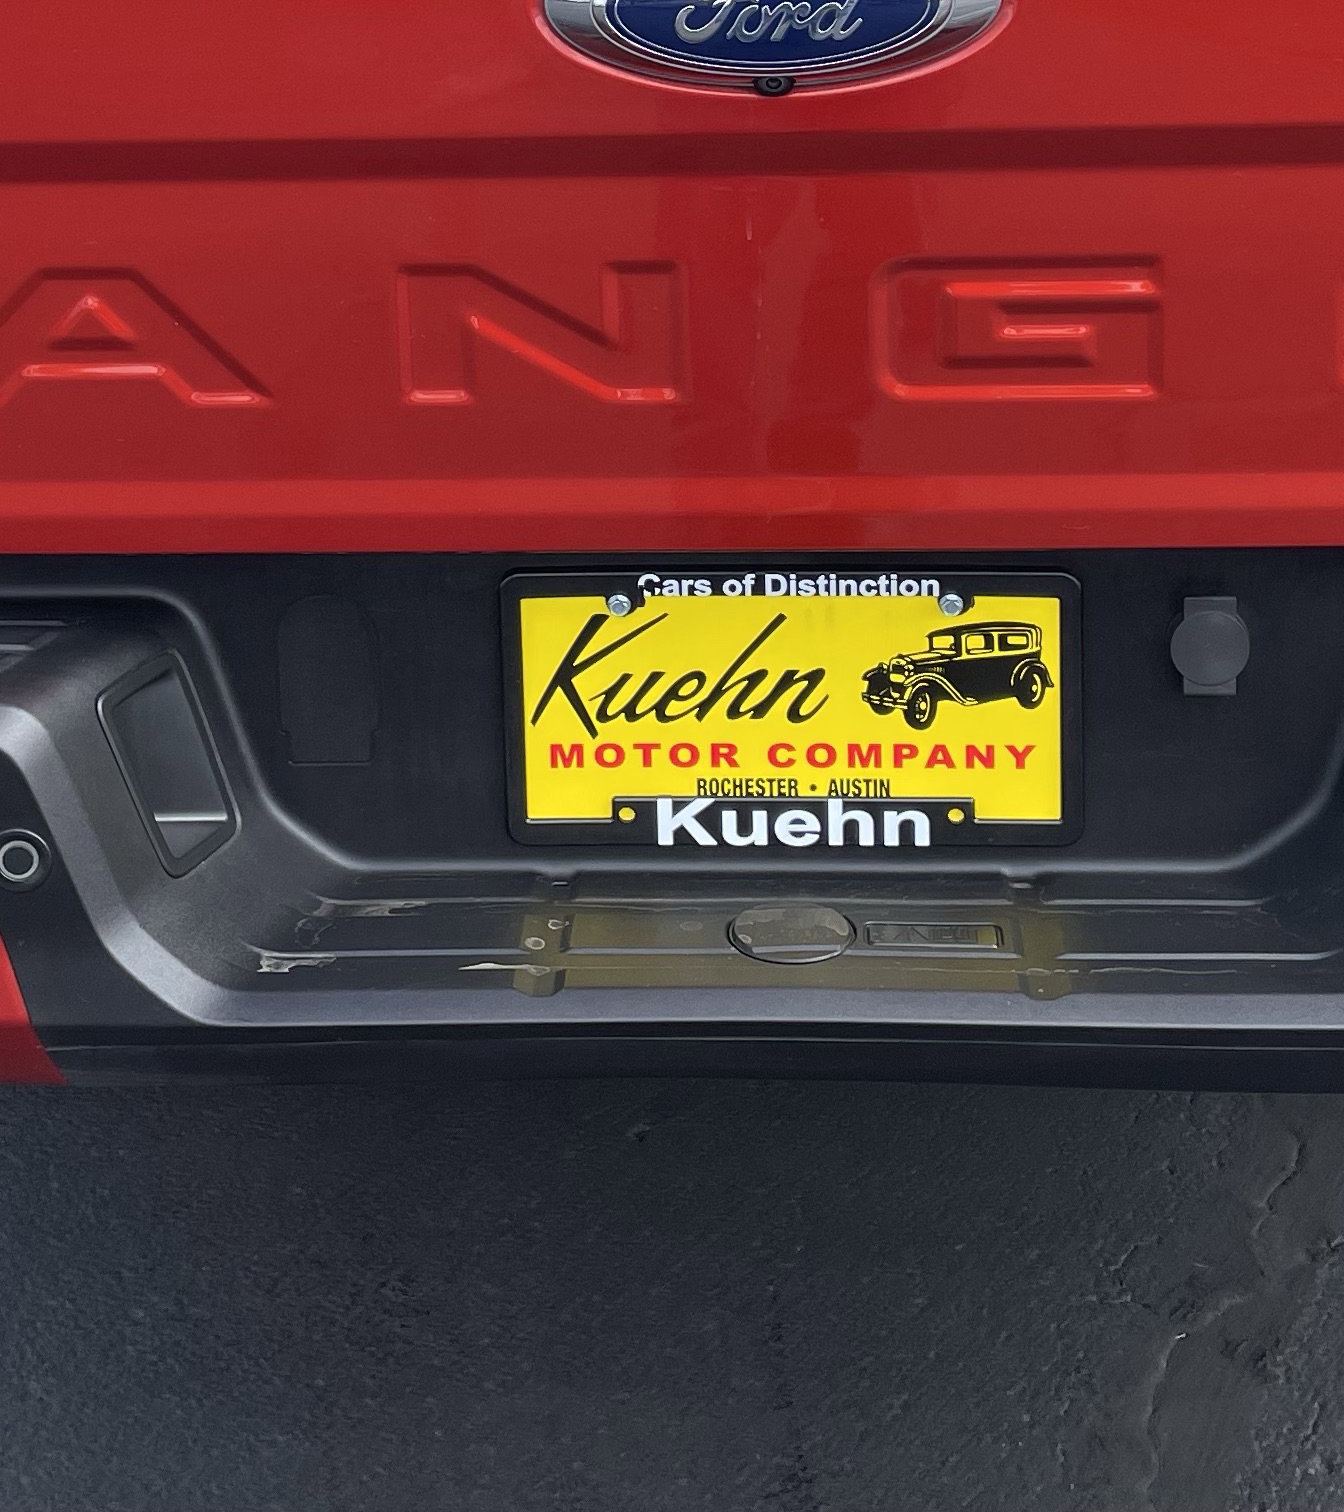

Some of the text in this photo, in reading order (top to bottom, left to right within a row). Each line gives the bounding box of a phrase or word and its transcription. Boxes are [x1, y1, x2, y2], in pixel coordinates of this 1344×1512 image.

[637, 572, 941, 598] Cars of Distinction
[530, 612, 830, 740] Kuehn
[549, 743, 1038, 770] MOTOR COMPANY
[696, 777, 892, 798] ROCHESTER AUSTIN
[655, 797, 932, 847] Kuehn
